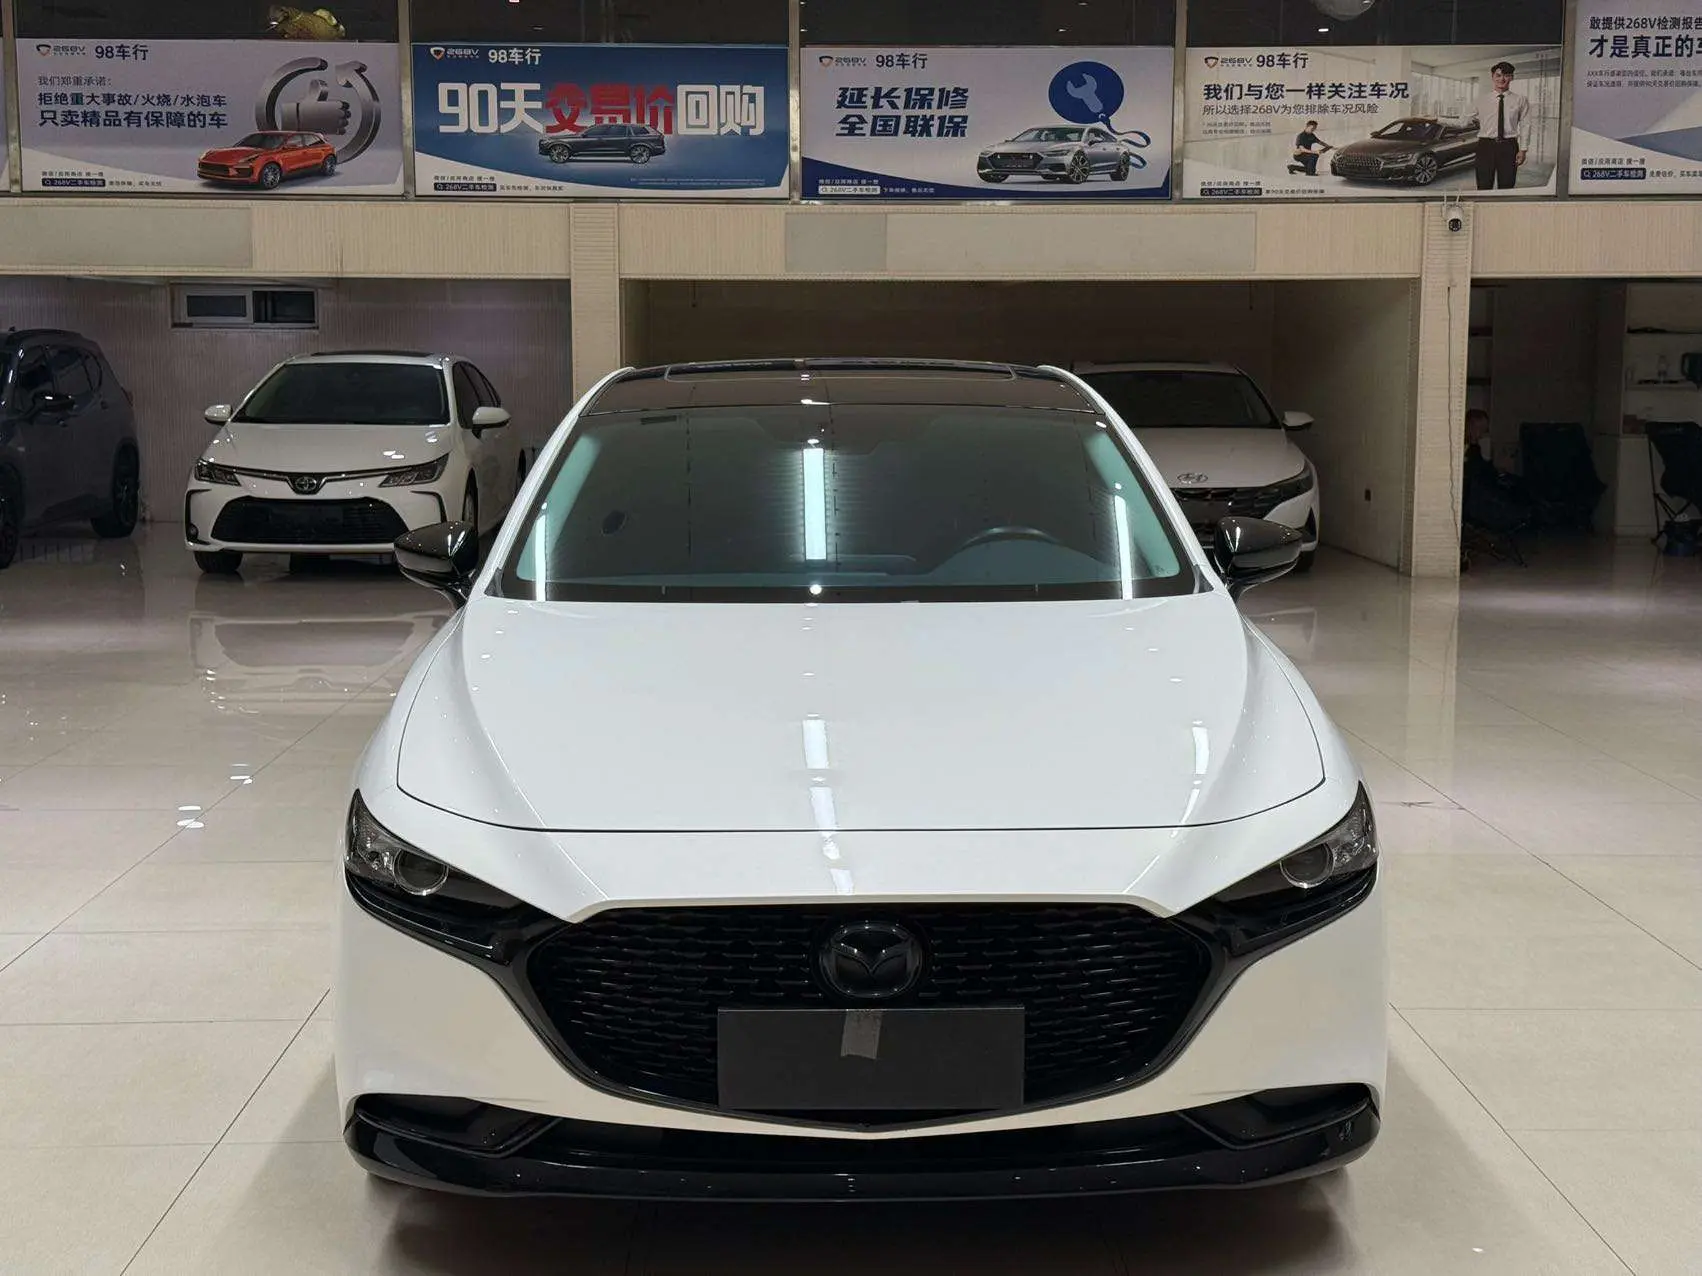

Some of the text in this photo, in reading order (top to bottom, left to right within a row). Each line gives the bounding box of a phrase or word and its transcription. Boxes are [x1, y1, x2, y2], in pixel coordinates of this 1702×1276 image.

[95, 44, 149, 61] 98车行
[488, 48, 542, 66] 98车行
[876, 53, 928, 70] 98车行
[1256, 53, 1309, 69] 98车行
[38, 92, 228, 108] 拒绝重大事故/火烧/水泡车
[835, 86, 969, 111] 延长保修
[1203, 82, 1410, 101] 我们与您一样关注车况
[438, 82, 766, 137] 90天交易价回购
[1202, 103, 1379, 116] 所以选择268V为您排除车况风险
[38, 110, 229, 130] 只卖精品有保障的车
[835, 114, 969, 138] 全国联保
